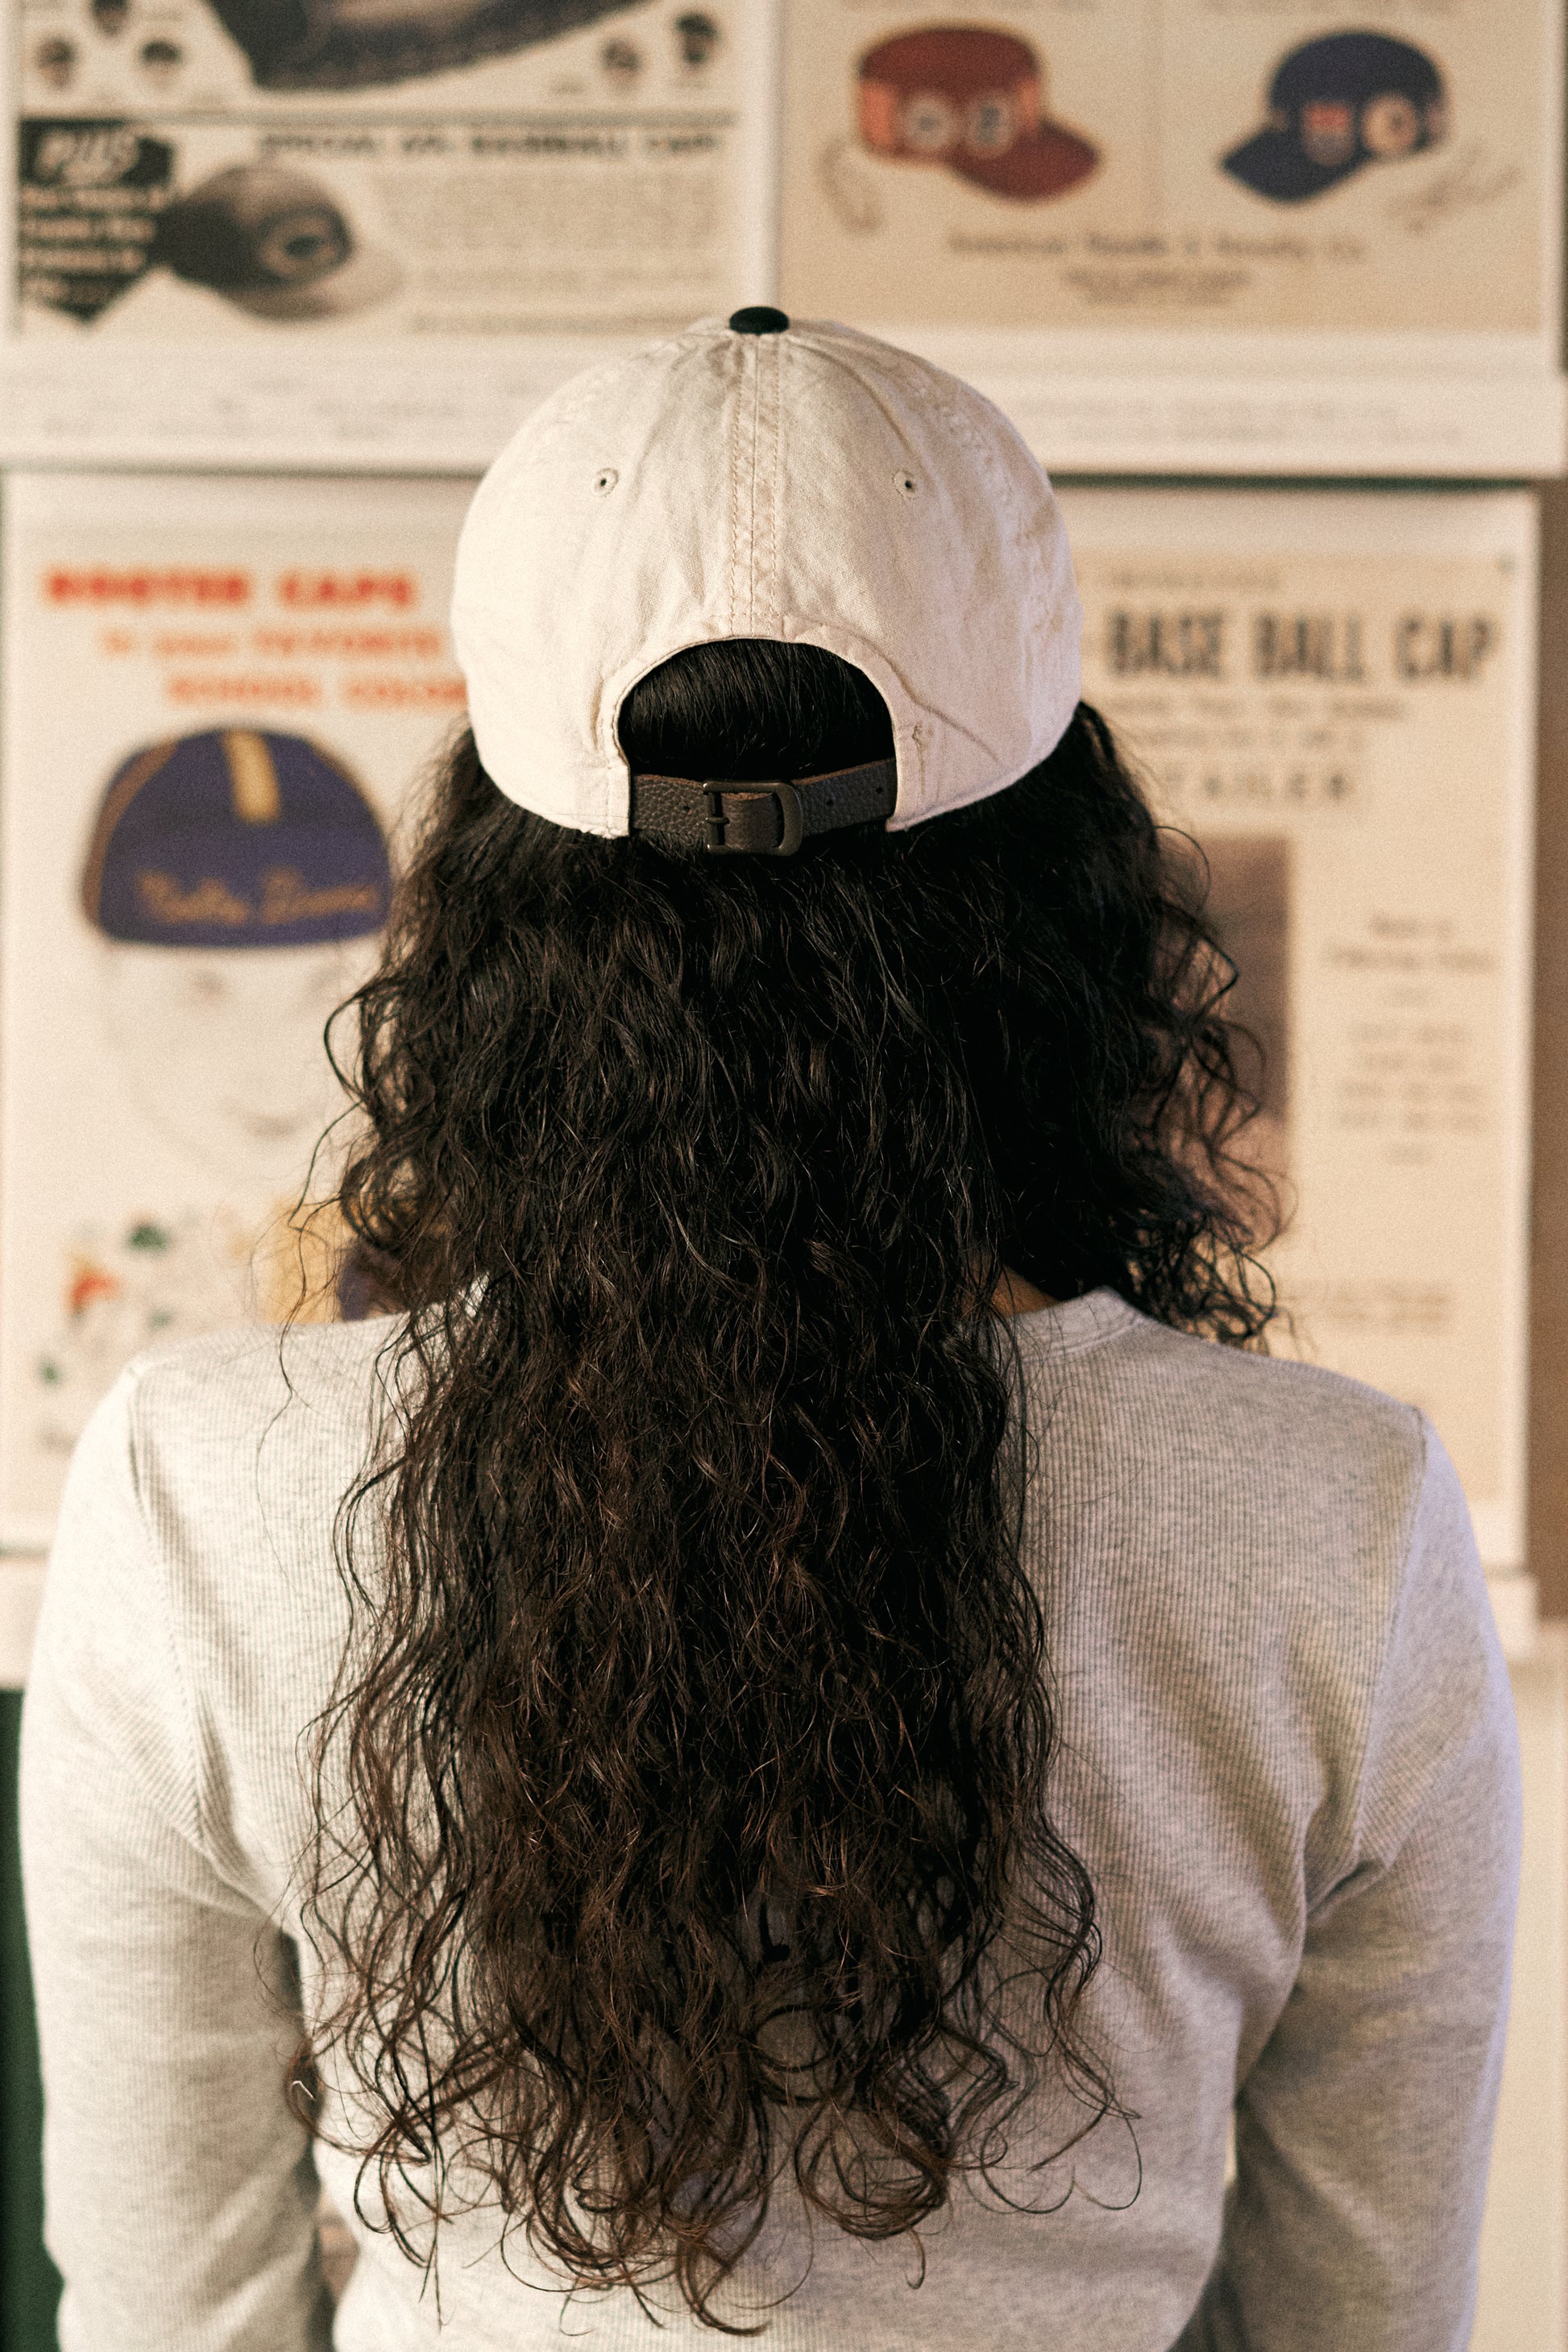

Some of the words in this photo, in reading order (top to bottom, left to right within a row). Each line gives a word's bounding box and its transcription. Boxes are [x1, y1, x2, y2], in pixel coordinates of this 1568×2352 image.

[1107, 608, 1223, 678] BASE
[1255, 610, 1364, 682] BALL
[1394, 610, 1496, 684] CAP
